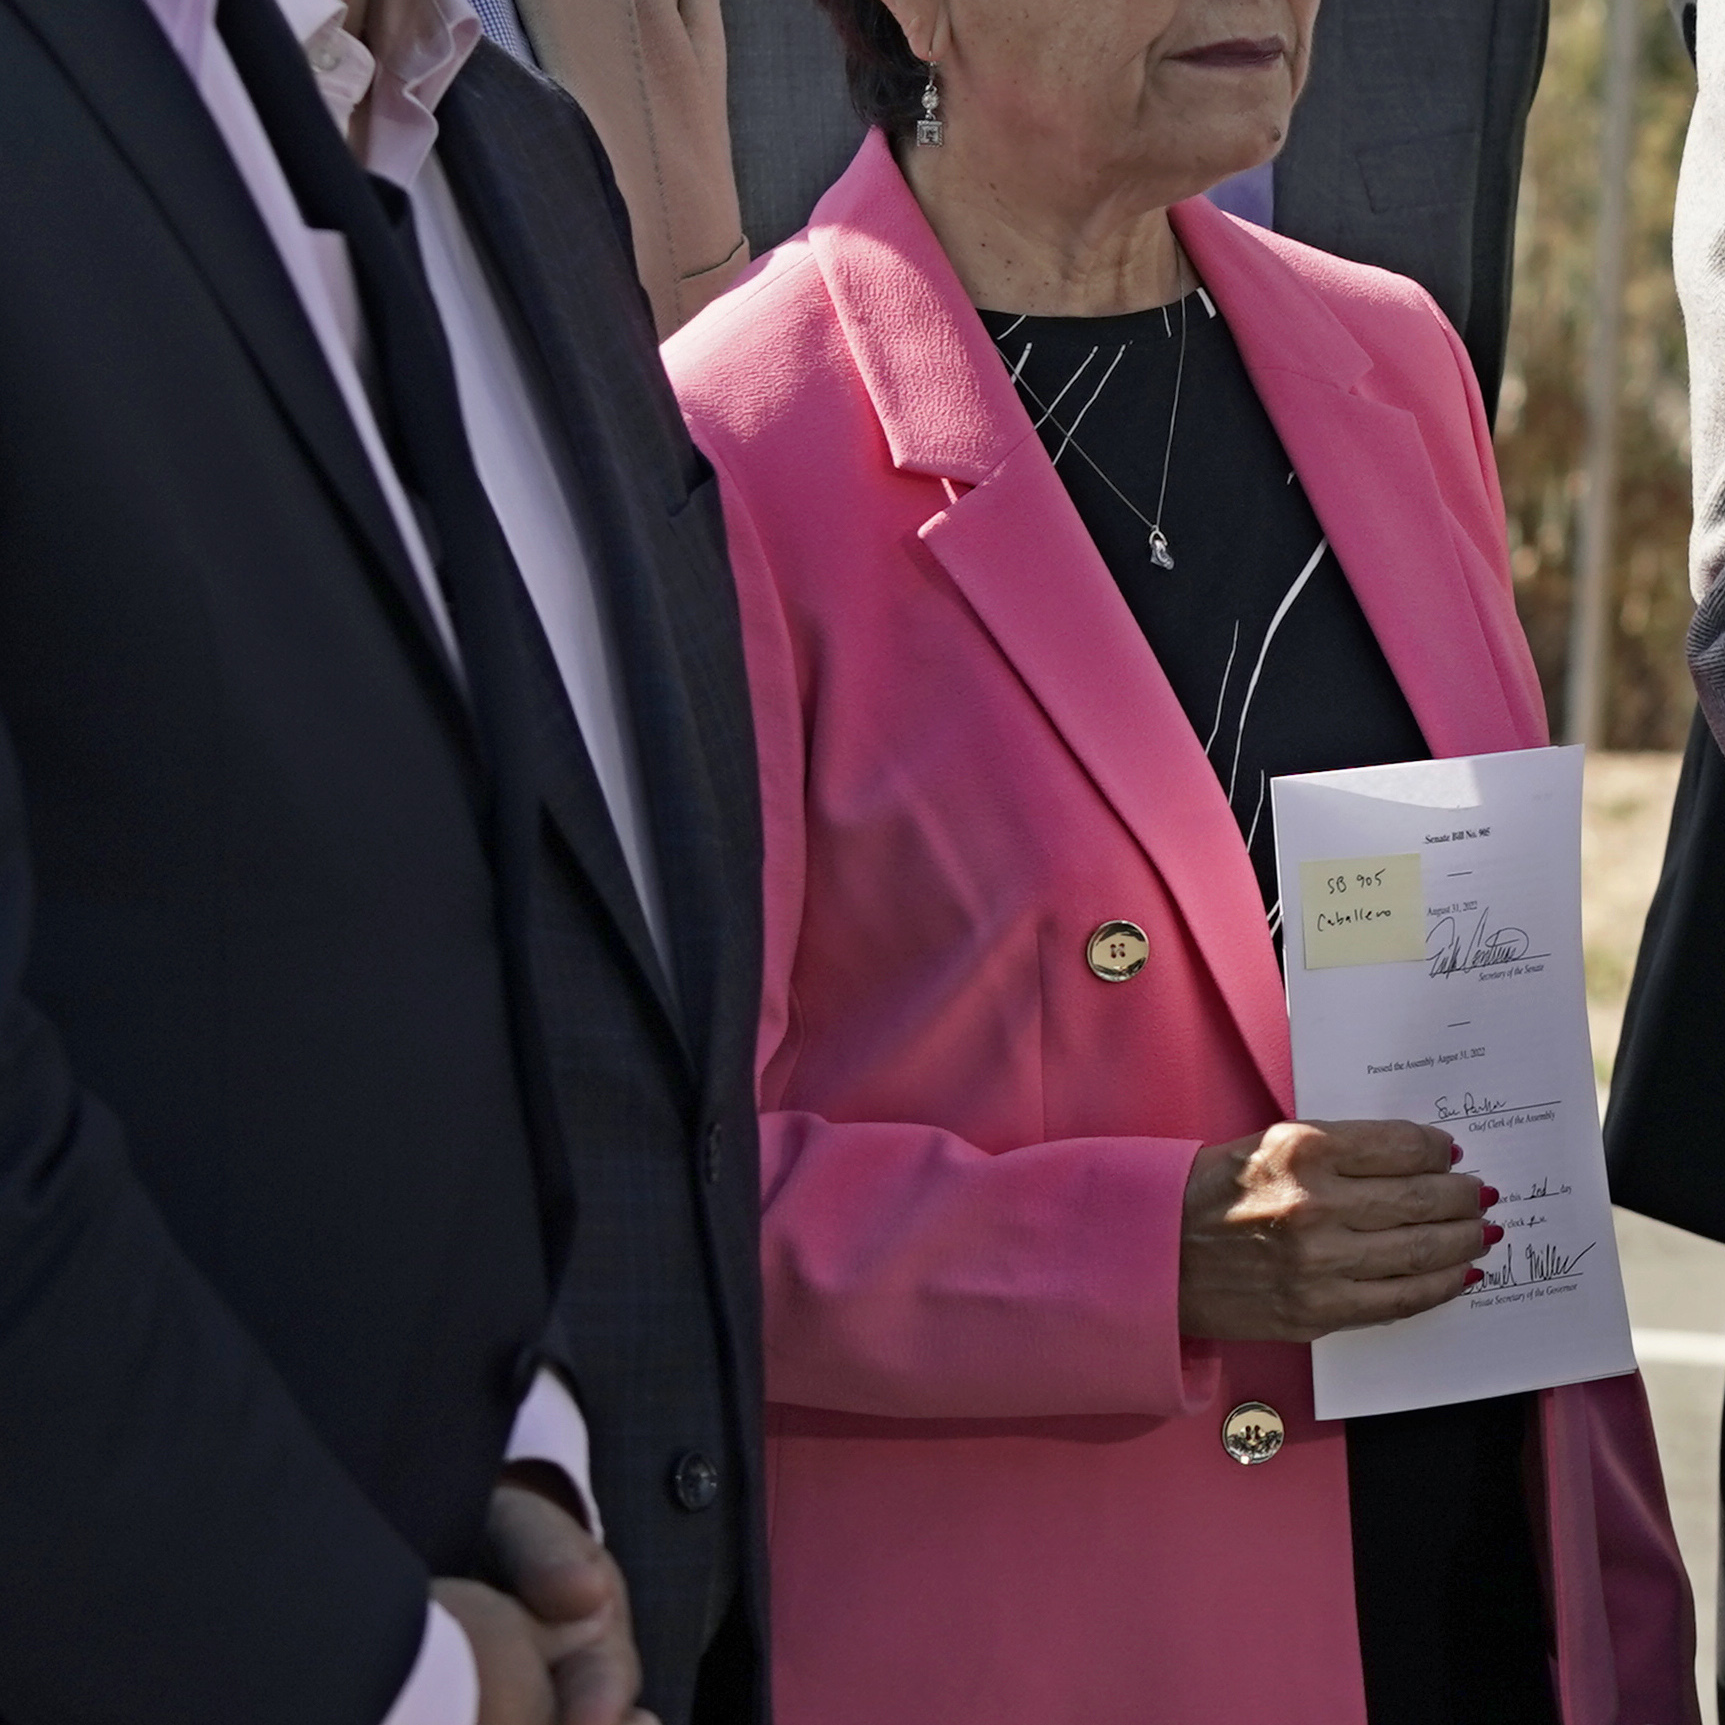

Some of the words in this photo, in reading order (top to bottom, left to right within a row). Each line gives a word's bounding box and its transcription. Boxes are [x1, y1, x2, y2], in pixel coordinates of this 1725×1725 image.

[1424, 834, 1450, 844] Senate
[1327, 876, 1347, 894] SB
[1356, 868, 1386, 887] 905
[1426, 906, 1450, 917] August
[1367, 1063, 1393, 1074] Passed
[1393, 1061, 1405, 1071] the
